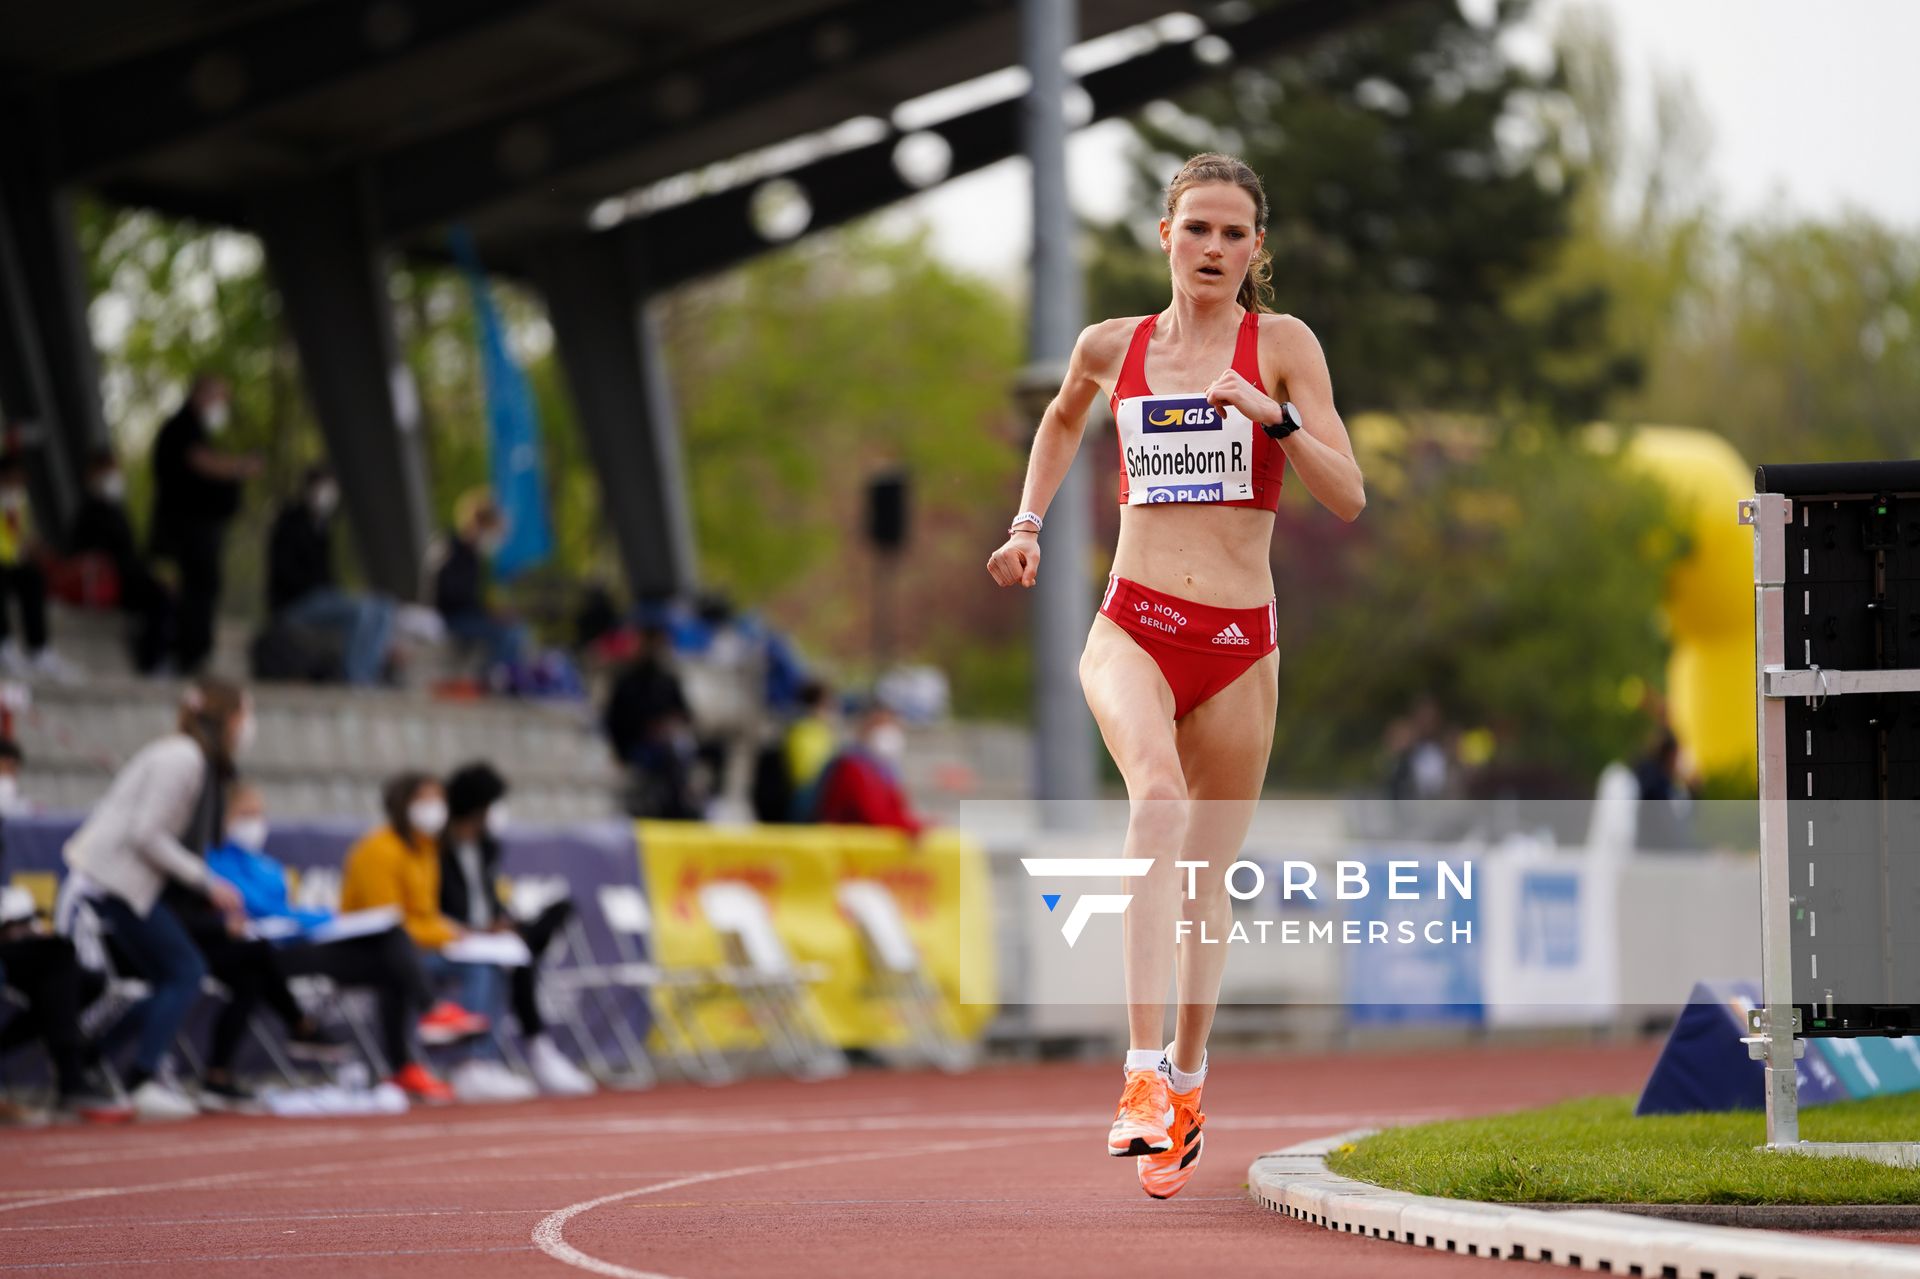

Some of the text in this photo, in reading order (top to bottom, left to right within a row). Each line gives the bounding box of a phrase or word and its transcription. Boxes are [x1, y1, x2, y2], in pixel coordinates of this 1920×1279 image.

[1184, 408, 1215, 425] GLS
[1127, 441, 1247, 478] Schöneborn R.
[1177, 488, 1221, 502] PLAN
[1134, 601, 1187, 626] LG NORD
[1140, 615, 1177, 635] BERLIN
[1212, 635, 1250, 646] adidas
